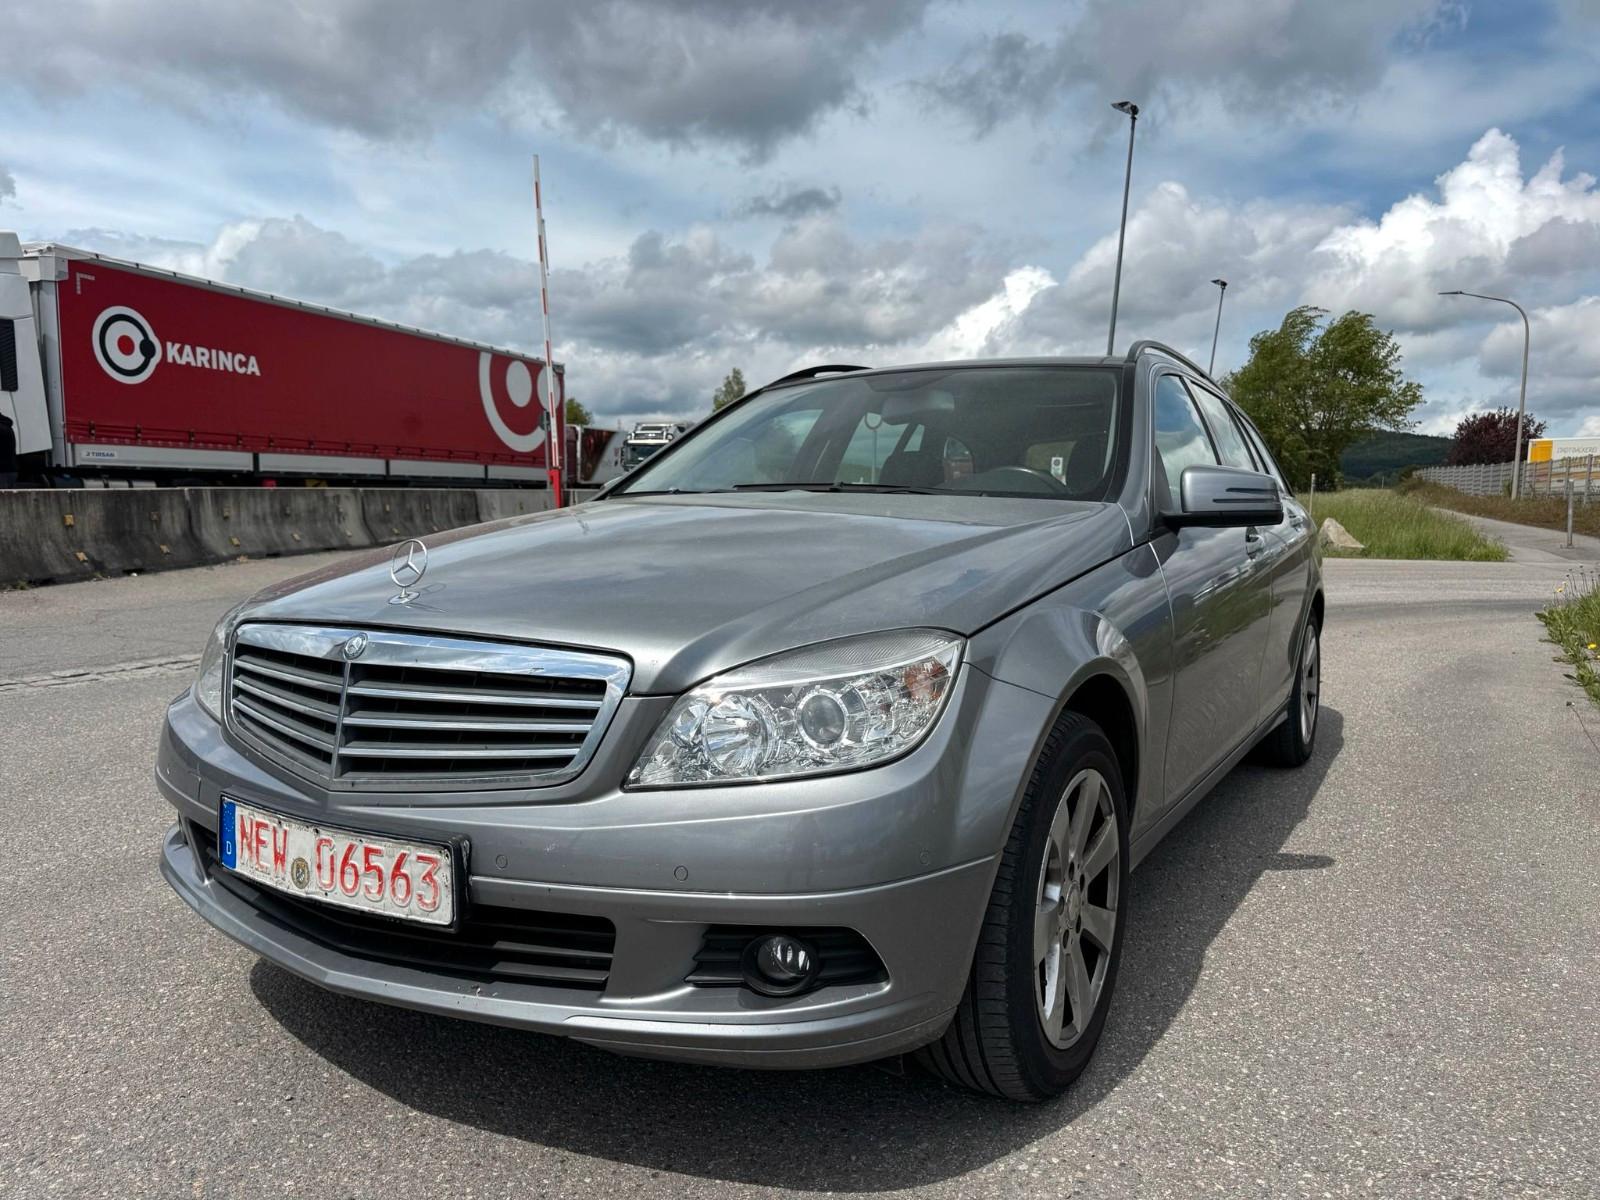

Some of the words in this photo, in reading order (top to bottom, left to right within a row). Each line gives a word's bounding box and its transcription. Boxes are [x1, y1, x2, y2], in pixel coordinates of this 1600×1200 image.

[166, 341, 261, 376] KARINCA
[226, 840, 232, 855] D
[239, 815, 289, 877] NEW
[315, 836, 442, 912] 06563
